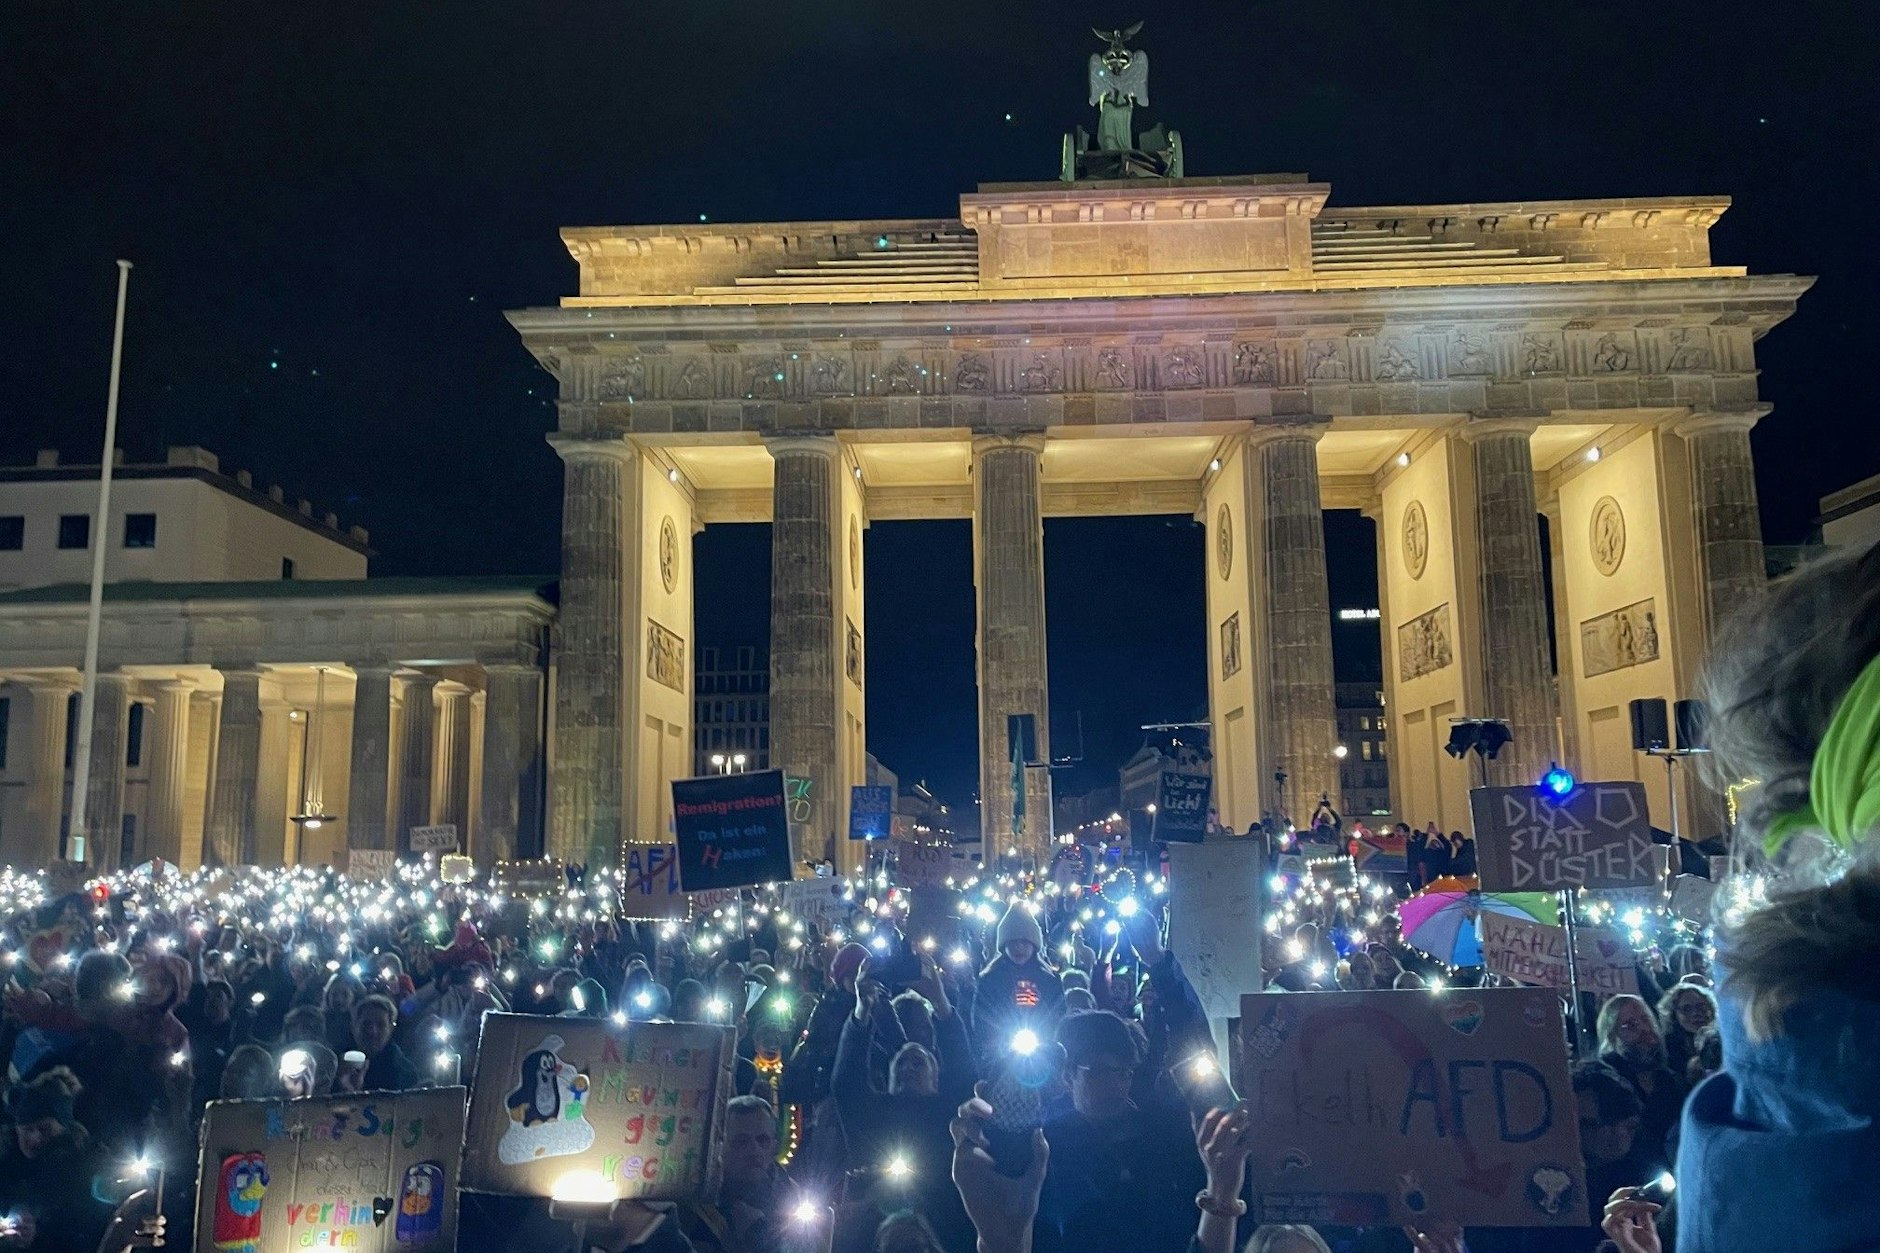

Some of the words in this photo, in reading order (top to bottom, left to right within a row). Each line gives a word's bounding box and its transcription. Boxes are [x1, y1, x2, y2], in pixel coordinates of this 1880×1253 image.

[1165, 794, 1201, 810] Licht
[698, 830, 716, 841] Da
[1510, 826, 1591, 853] STATT
[1511, 832, 1653, 887] DÜSTER
[1400, 1056, 1553, 1144] AFD
[300, 1229, 358, 1248] dern
